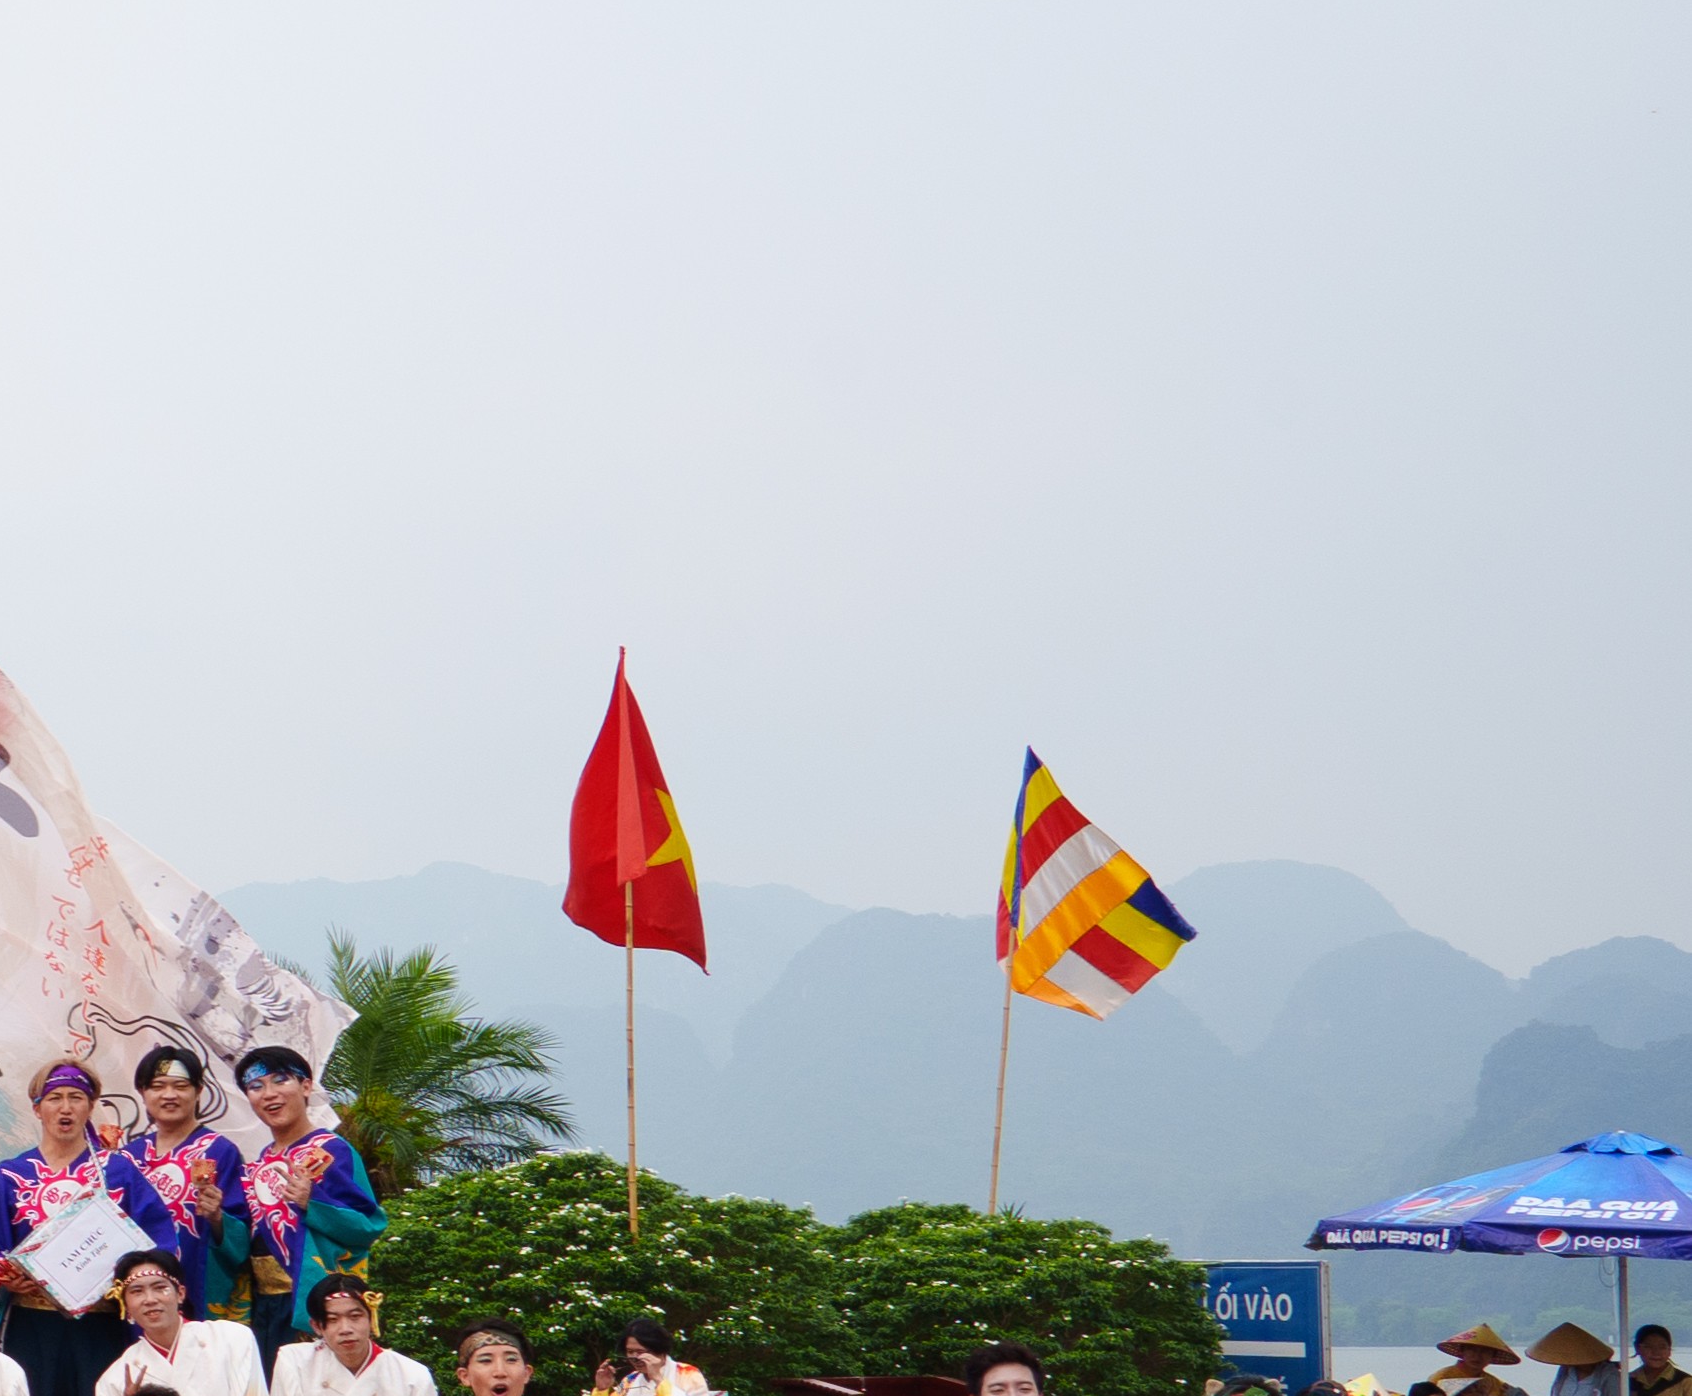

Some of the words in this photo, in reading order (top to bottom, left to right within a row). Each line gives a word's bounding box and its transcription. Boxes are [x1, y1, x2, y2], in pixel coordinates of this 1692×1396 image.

[1506, 1206, 1616, 1219] PEPSI
[1379, 1230, 1422, 1246] PEPSI
[1573, 1235, 1641, 1252] pepsi
[1244, 1286, 1293, 1322] VÀO
